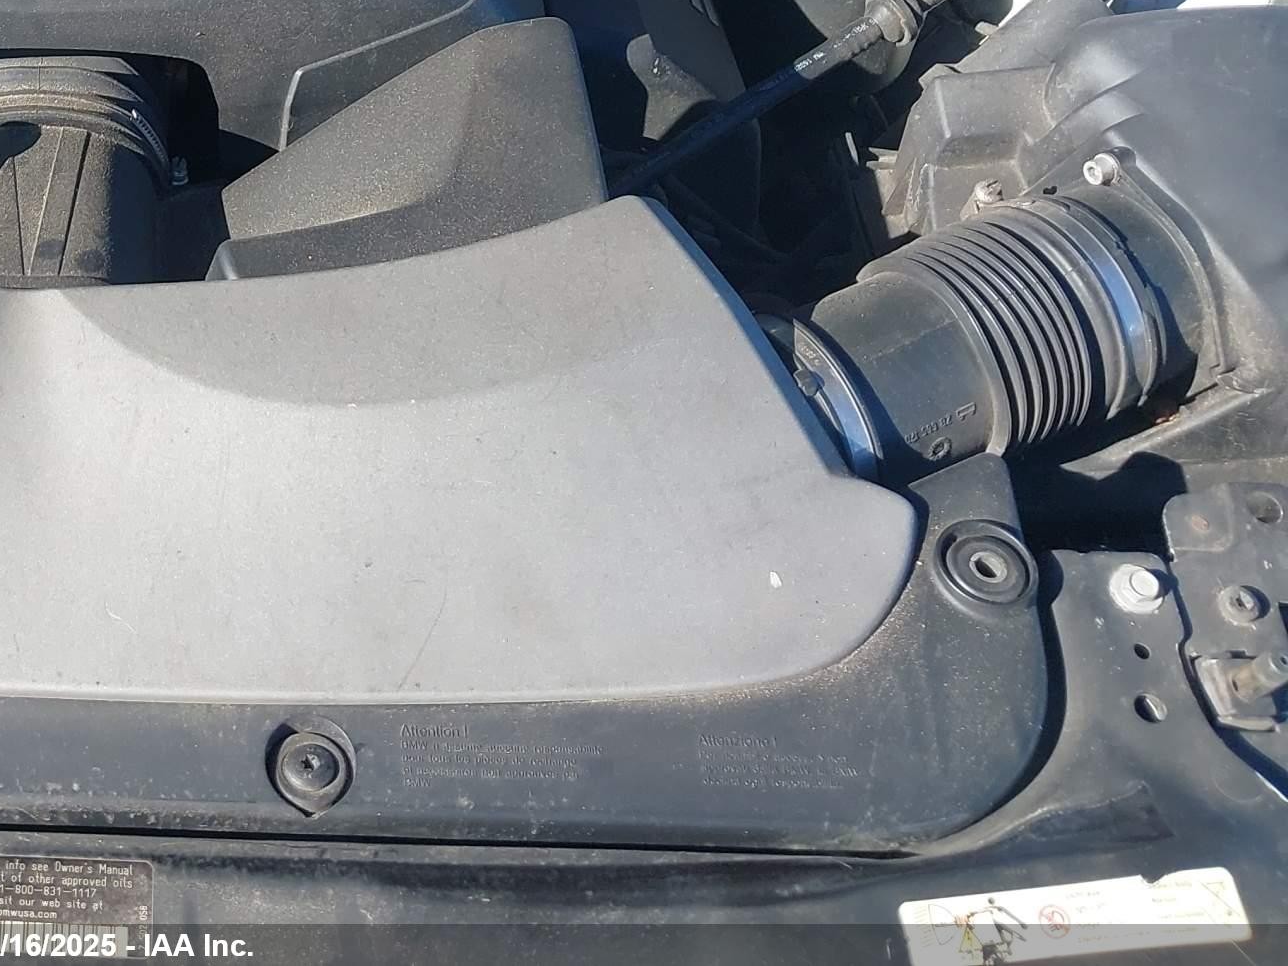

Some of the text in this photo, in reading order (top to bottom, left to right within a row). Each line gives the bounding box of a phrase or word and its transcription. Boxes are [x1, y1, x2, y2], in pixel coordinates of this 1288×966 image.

[5, 859, 26, 871] info
[32, 863, 49, 871] see
[55, 861, 93, 874] Owner's
[99, 865, 133, 876] Manual
[11, 873, 23, 883] of
[28, 874, 55, 884] other
[61, 876, 107, 888] approved
[113, 878, 133, 888] oils
[0, 885, 97, 898] 1-800-831-1117
[19, 899, 35, 907] our
[42, 898, 60, 908] web
[67, 900, 87, 910] site
[92, 901, 103, 911] at
